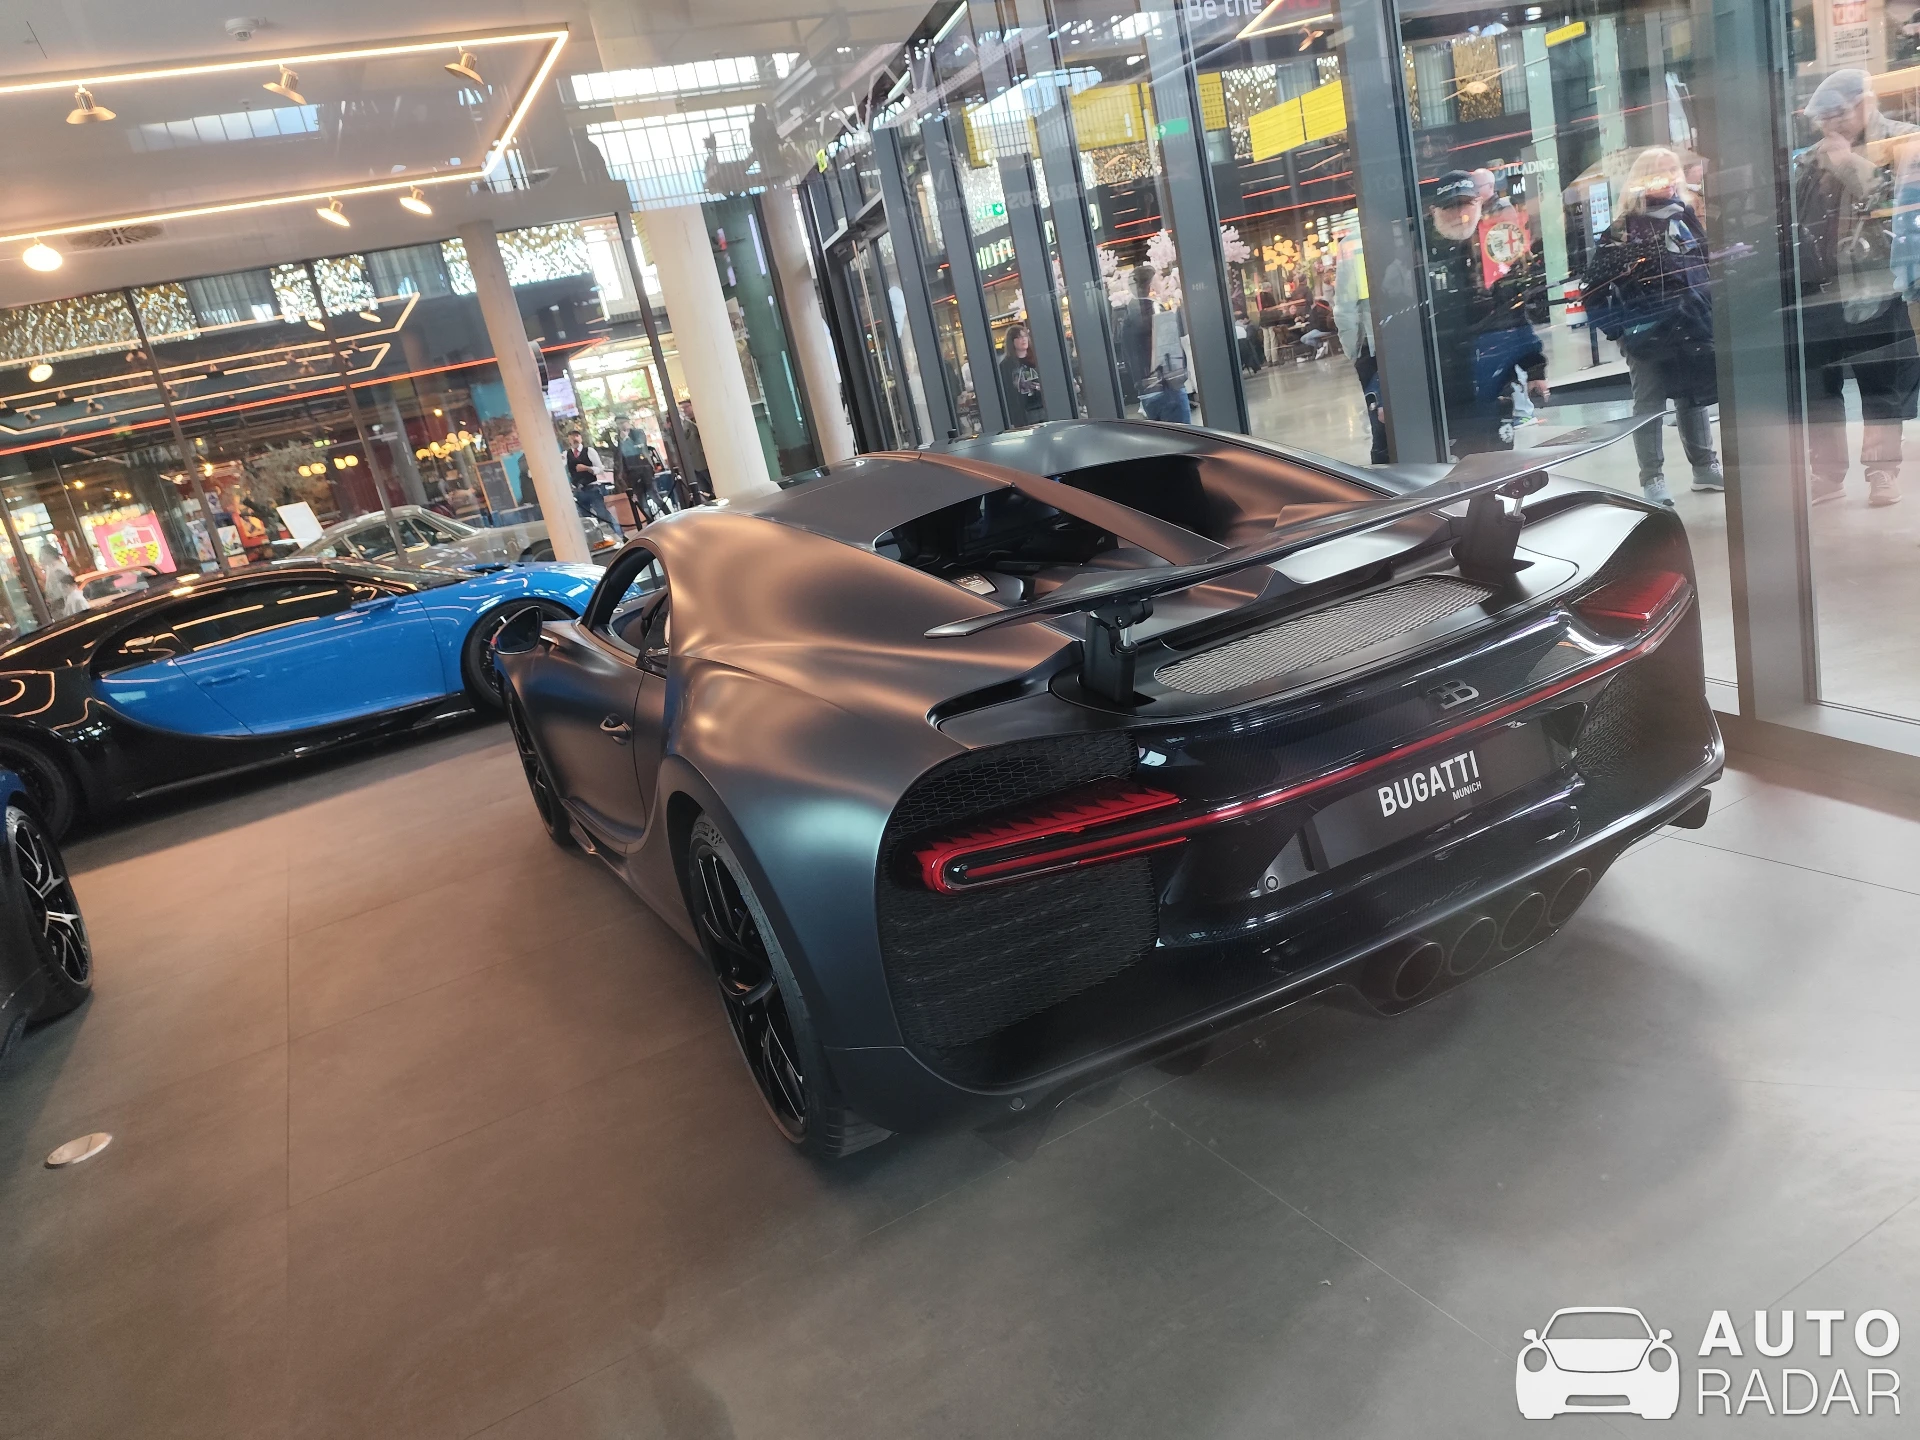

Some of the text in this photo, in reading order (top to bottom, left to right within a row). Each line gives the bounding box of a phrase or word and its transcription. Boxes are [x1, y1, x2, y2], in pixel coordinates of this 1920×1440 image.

[1188, 0, 1217, 22] Be
[1225, 0, 1262, 17] the
[1507, 158, 1555, 177] TRADING
[1377, 750, 1480, 818] BUGATTI
[1452, 781, 1482, 801] MUNICH
